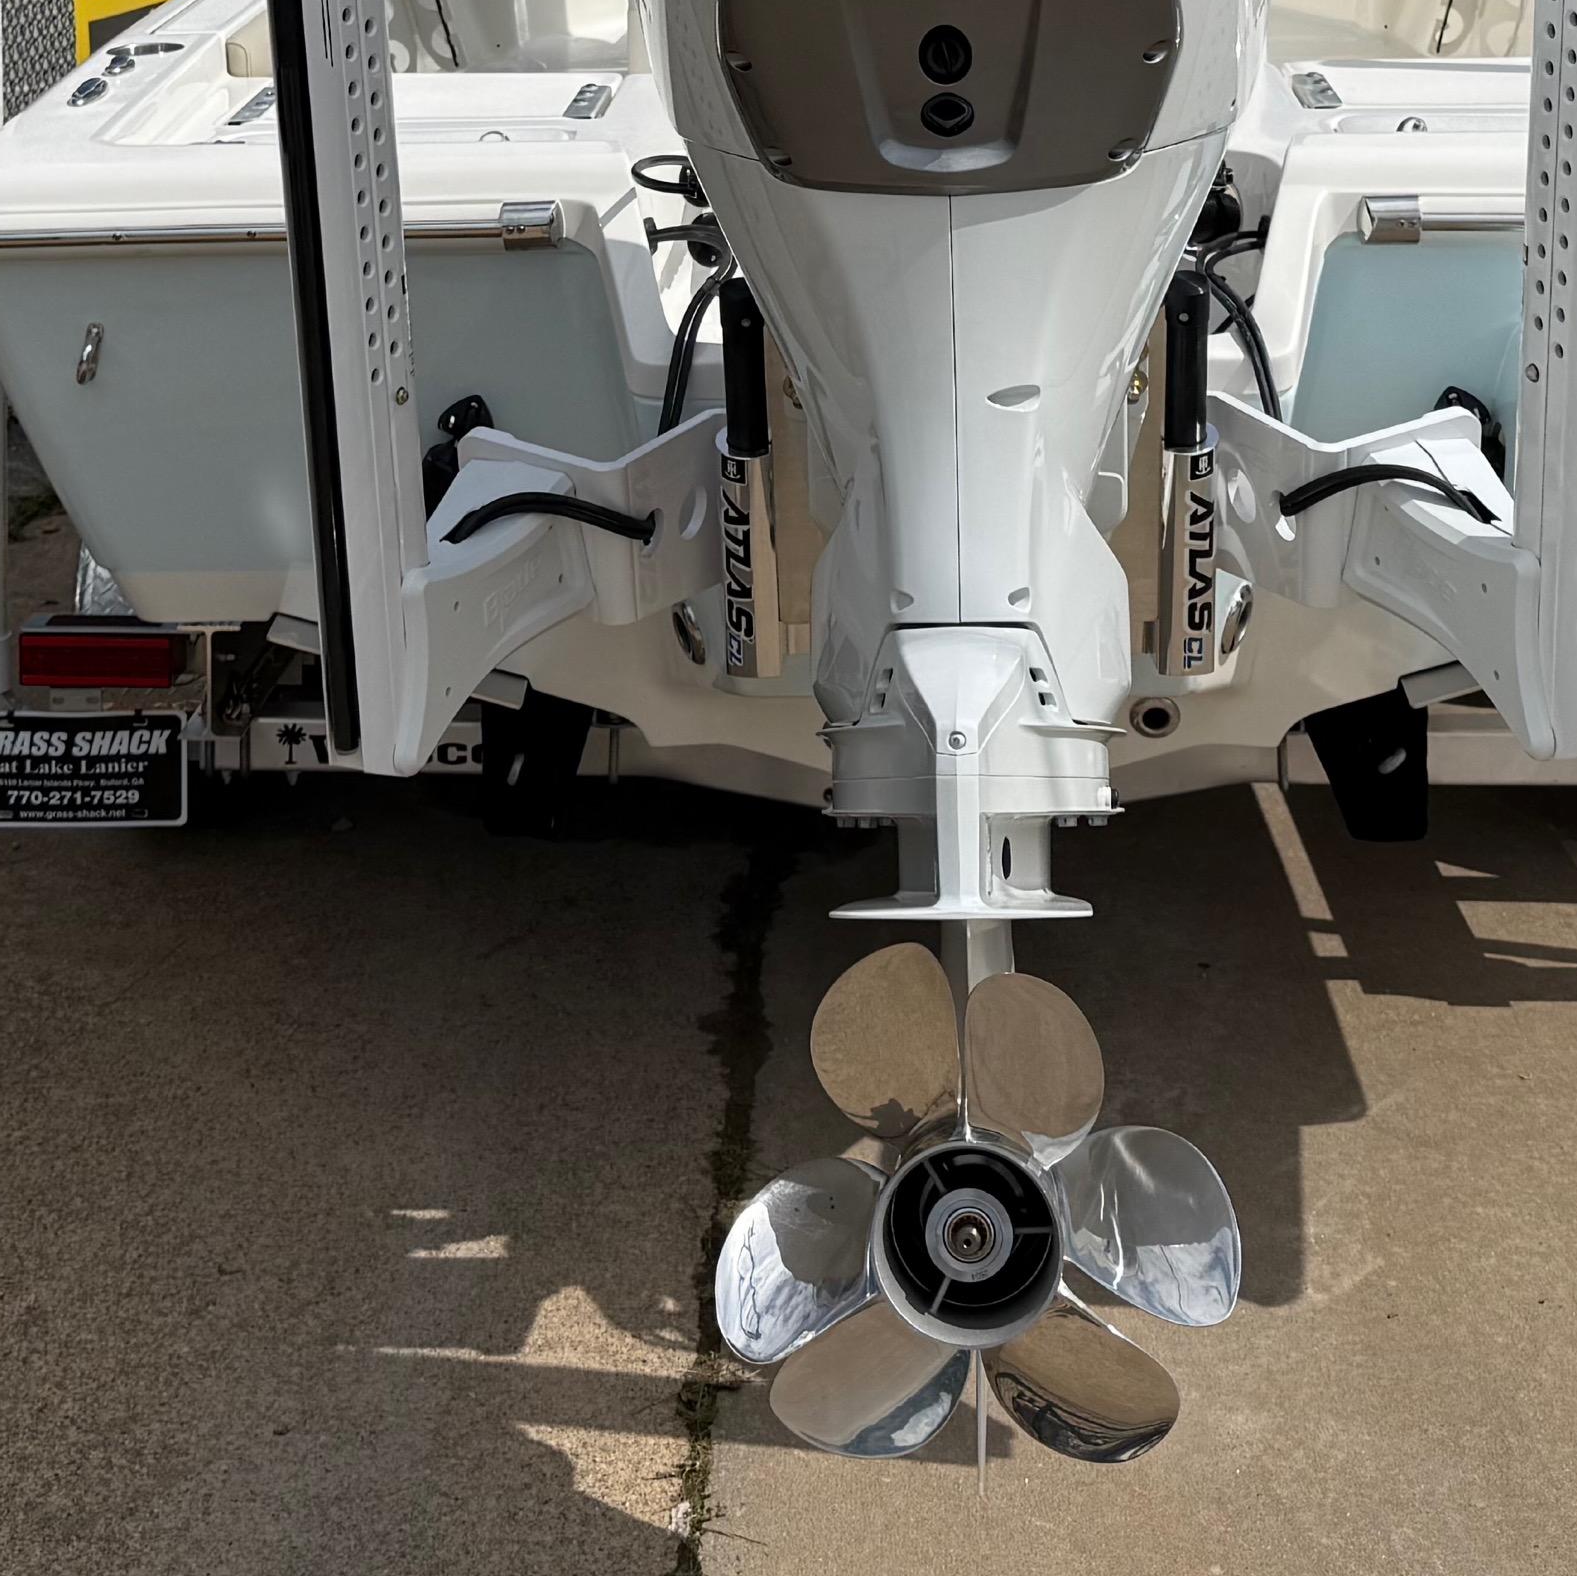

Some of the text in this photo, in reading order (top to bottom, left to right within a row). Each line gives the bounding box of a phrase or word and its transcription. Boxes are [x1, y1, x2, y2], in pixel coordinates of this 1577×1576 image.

[721, 486, 755, 643] ATLAS
[1187, 490, 1215, 633] ATLAS
[72, 728, 172, 757] SHACK
[0, 758, 149, 774] at Lake Lanier
[7, 789, 140, 805] 770-271-7529
[19, 808, 126, 820] www.grass-shack.net
